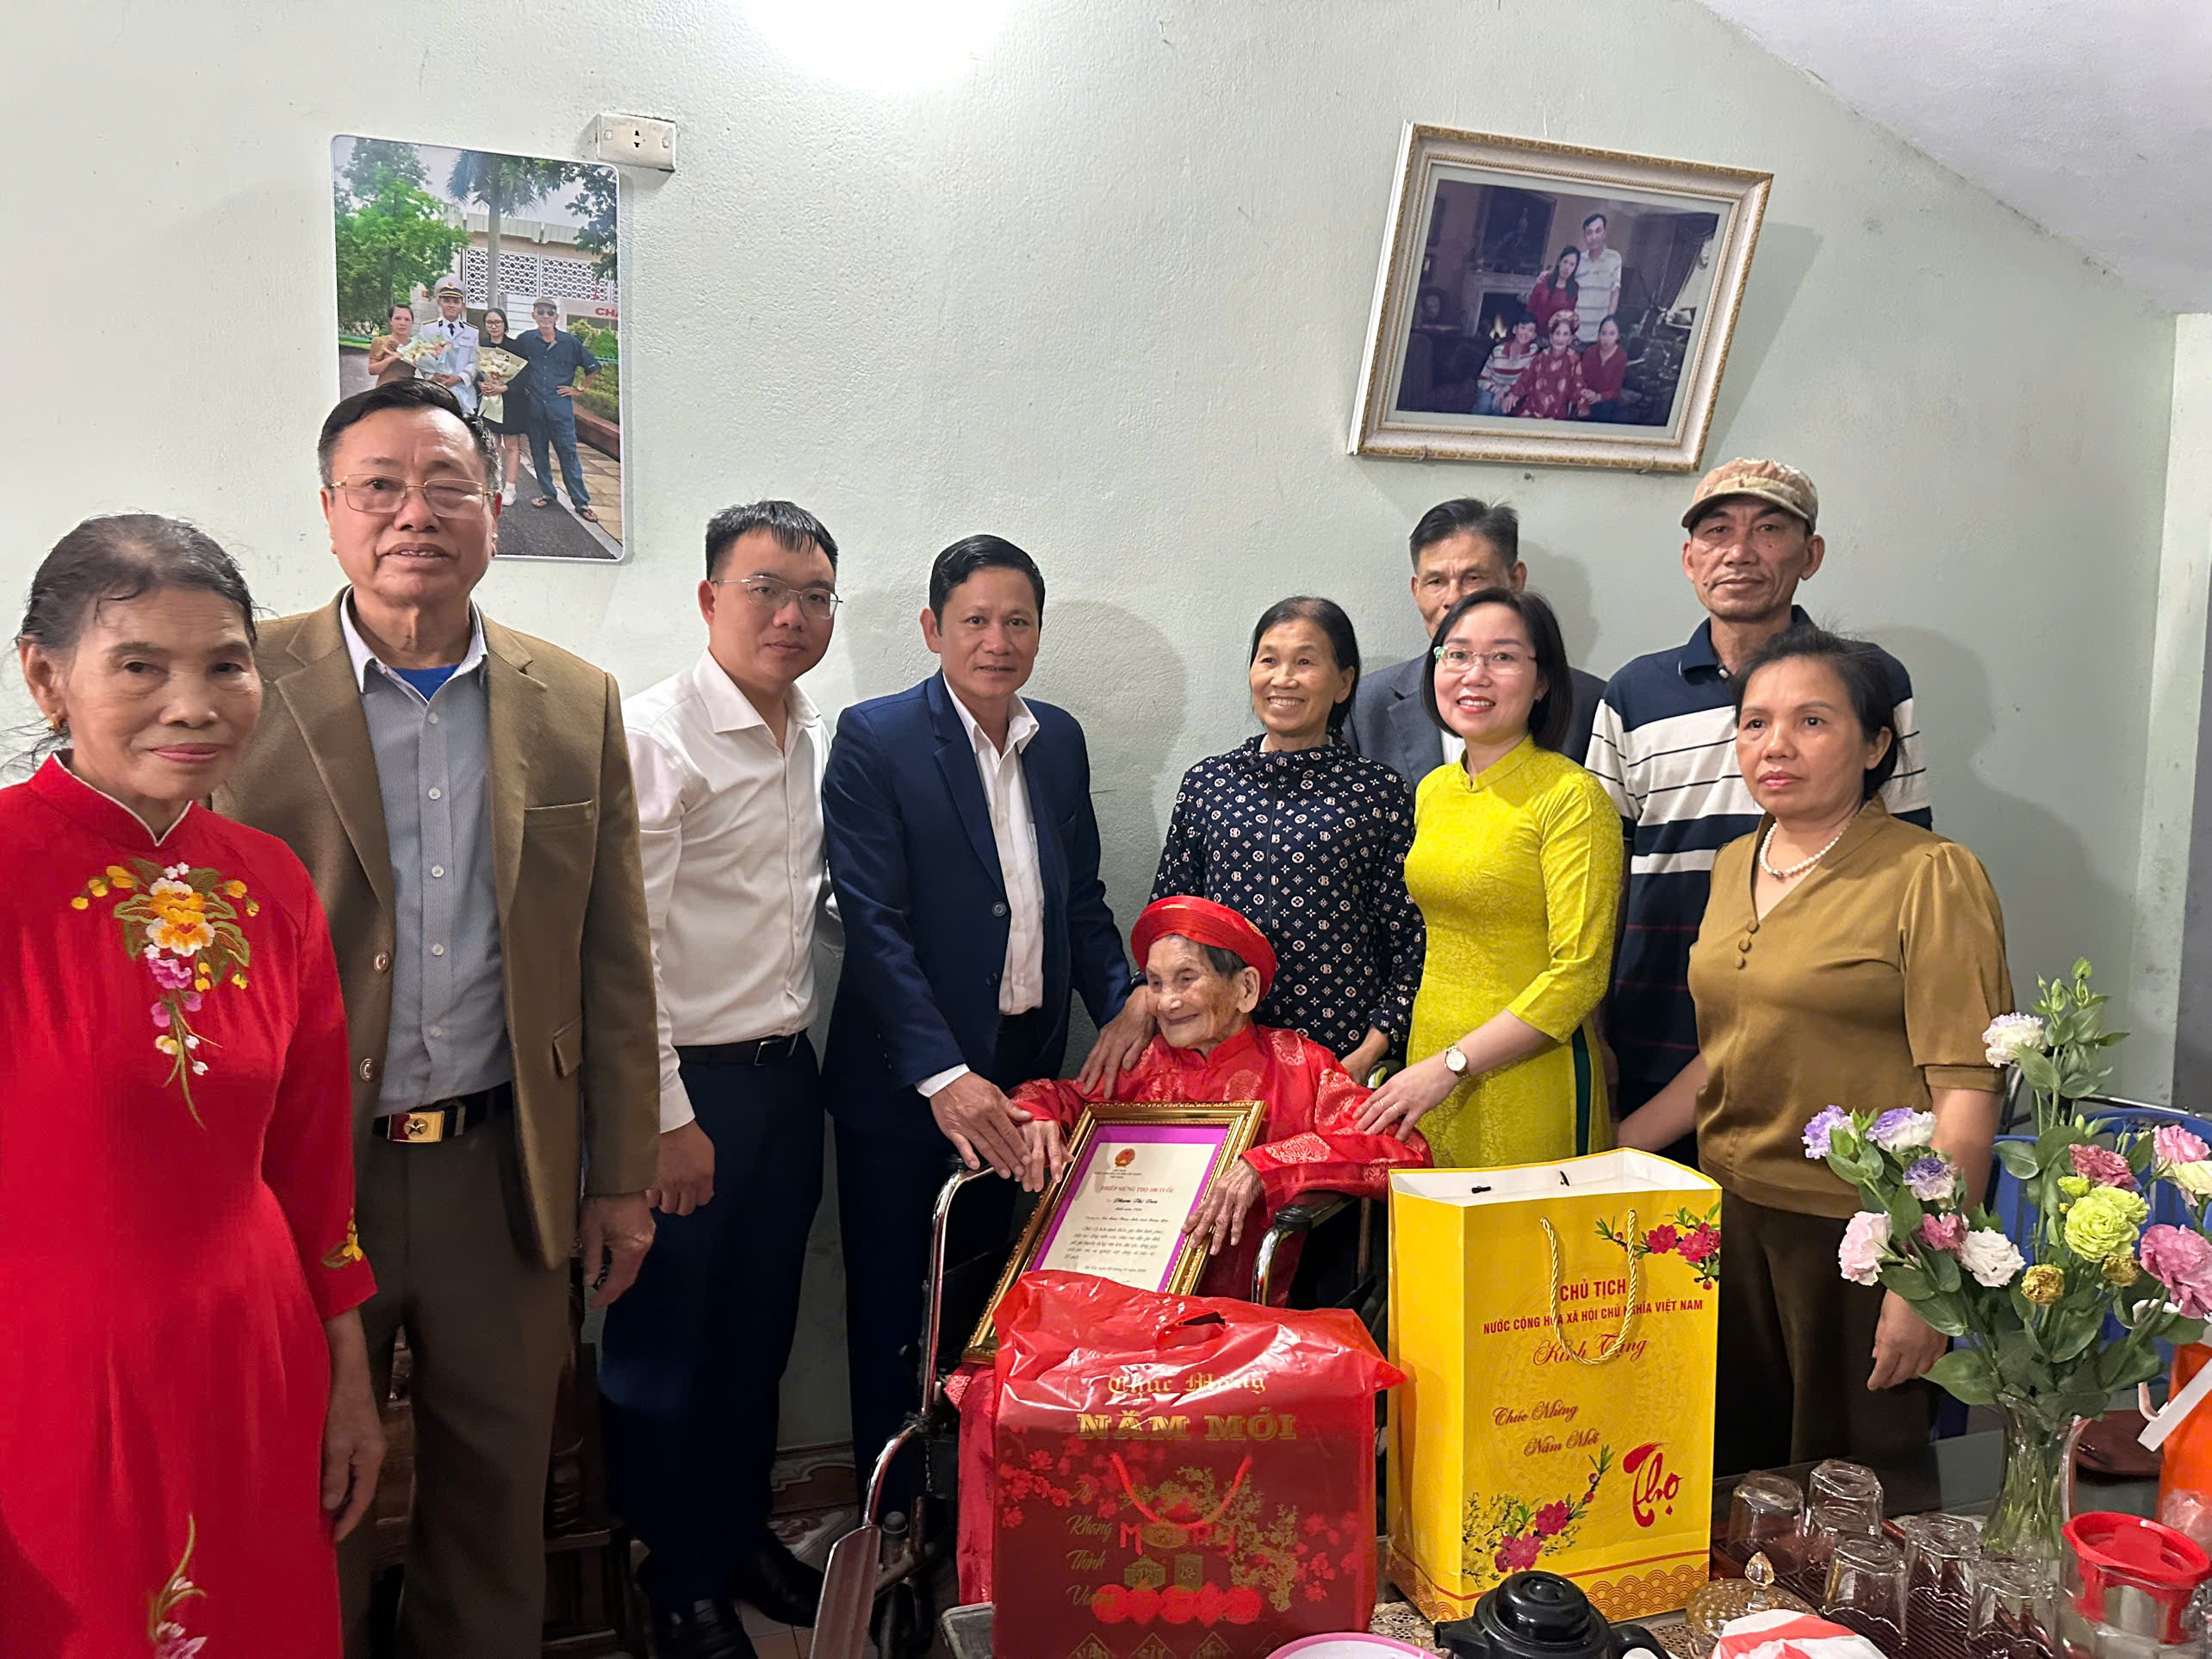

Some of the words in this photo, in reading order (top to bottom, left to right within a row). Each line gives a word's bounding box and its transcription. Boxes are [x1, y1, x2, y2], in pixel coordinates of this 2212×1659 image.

[1560, 1278, 1589, 1302] CHỦ
[1594, 1279, 1626, 1300] TỊCH
[1483, 1319, 1510, 1334] NƯỚC
[1513, 1316, 1540, 1332] CỘNG
[1566, 1309, 1578, 1324] XÃ
[1581, 1308, 1598, 1323] HỘI
[1601, 1303, 1620, 1319] CHỦ
[1655, 1298, 1676, 1312] VIỆT
[1681, 1300, 1703, 1311] NAM
[1077, 1409, 1191, 1440] NĂM
[1204, 1406, 1297, 1441] MỚI
[1493, 1406, 1529, 1426] Chúc
[1532, 1399, 1579, 1423] Mừng
[1524, 1435, 1563, 1457] Năm
[1566, 1428, 1600, 1449] Mới
[1622, 1441, 1684, 1528] Thọ
[1066, 1514, 1115, 1543] Khang
